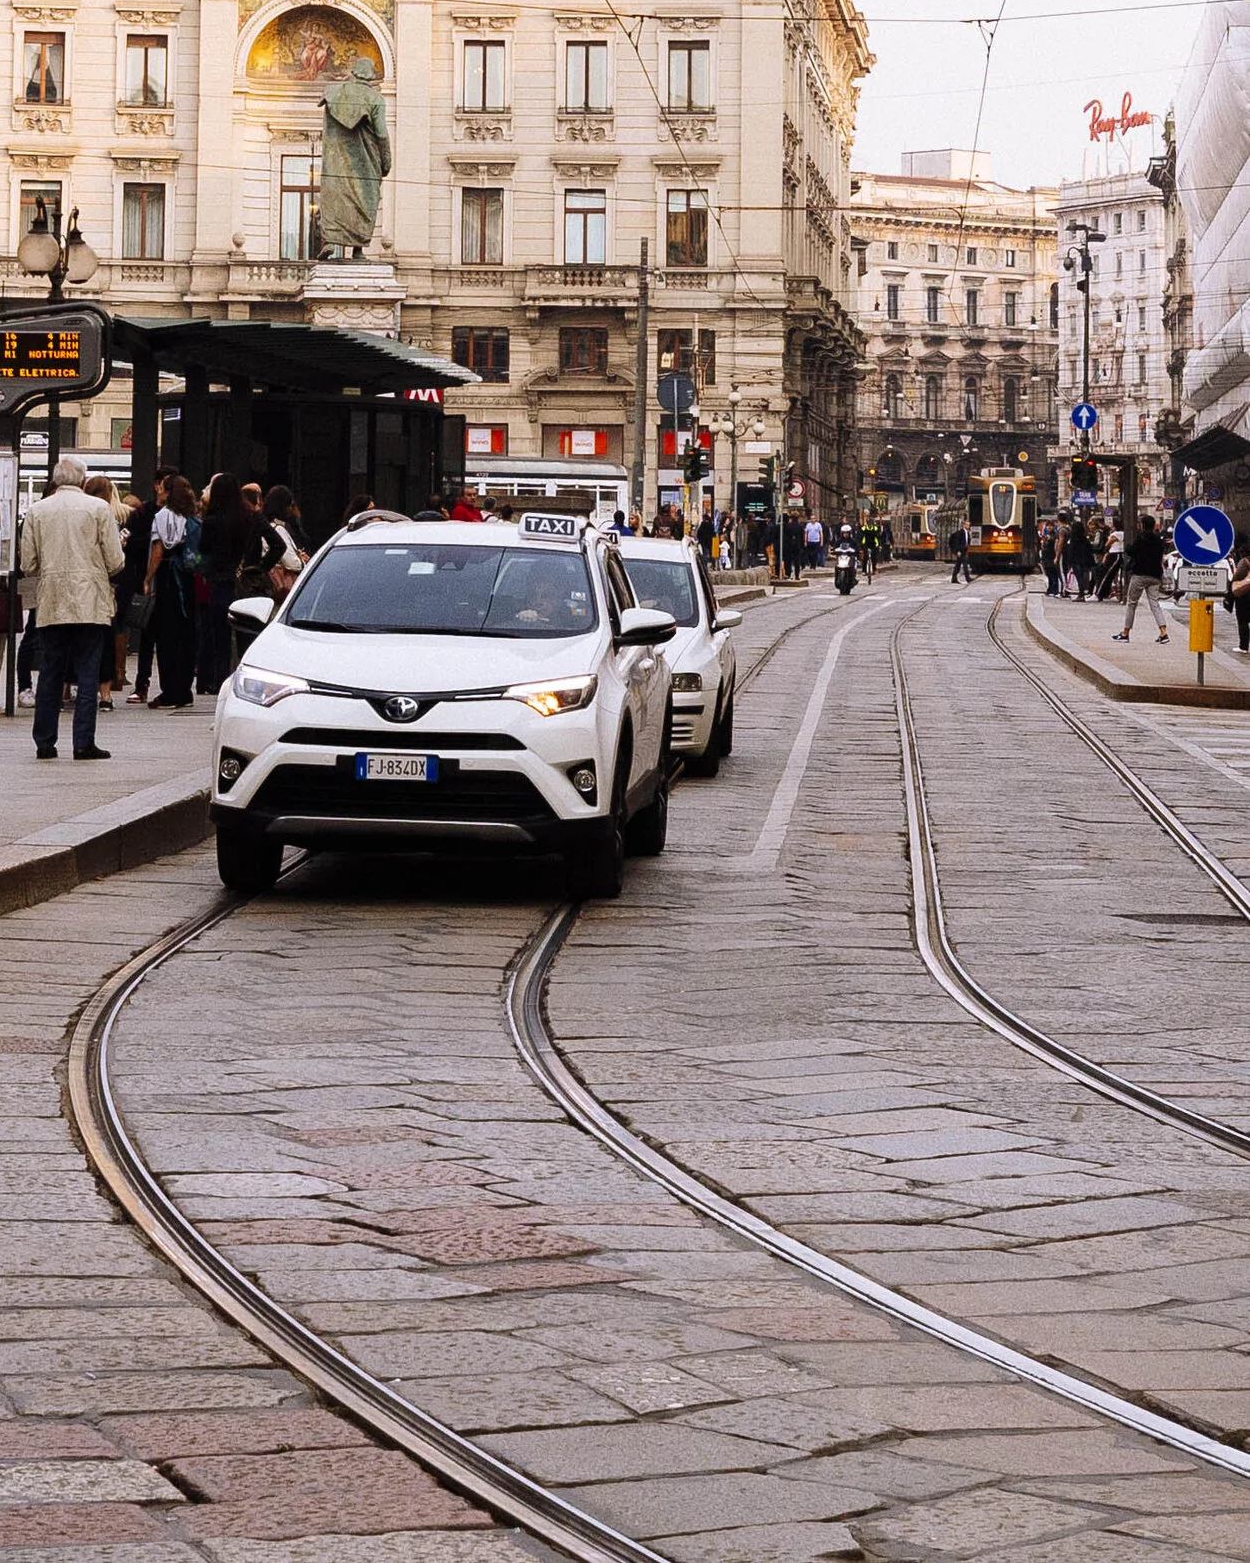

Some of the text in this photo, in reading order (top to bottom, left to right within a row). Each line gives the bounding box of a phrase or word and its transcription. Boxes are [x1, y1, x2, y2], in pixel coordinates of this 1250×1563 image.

[5, 332, 79, 340] 16 4 MIN
[5, 341, 79, 349] 19 4 MIN
[4, 350, 79, 358] M1 NOTTURNA
[527, 518, 572, 534] TAXI
